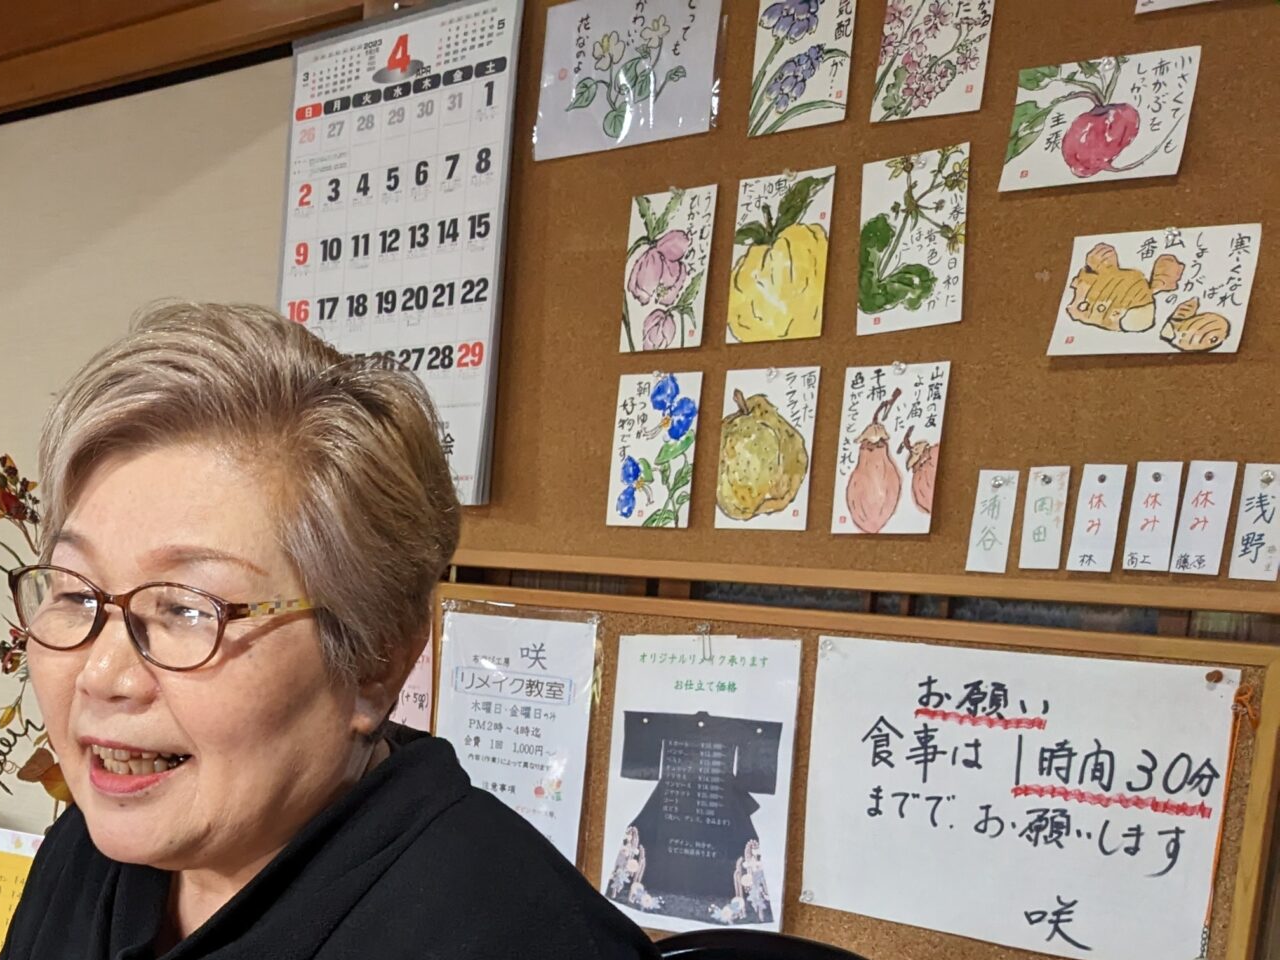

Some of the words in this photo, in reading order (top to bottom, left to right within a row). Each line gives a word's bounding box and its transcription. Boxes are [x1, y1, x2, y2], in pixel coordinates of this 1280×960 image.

[387, 34, 411, 73] 4
[305, 106, 313, 118] 日
[333, 100, 341, 111] 月
[362, 93, 371, 105] 火
[392, 86, 403, 98] 水
[422, 78, 432, 90] 木
[452, 69, 463, 82] 金
[485, 61, 497, 74] 土
[298, 126, 316, 144] 26
[327, 121, 345, 138] 27
[356, 113, 374, 132] 28
[387, 107, 406, 126] 29
[416, 99, 434, 119] 30
[447, 92, 464, 111] 31
[484, 81, 495, 107] 1
[298, 183, 312, 207] 2
[327, 178, 341, 202] 3
[356, 173, 370, 196] 4
[385, 167, 400, 191] 5
[415, 161, 429, 185] 6
[445, 154, 460, 180] 7
[475, 148, 491, 174] 8
[294, 242, 309, 266] 9
[320, 237, 342, 262] 10
[351, 233, 370, 257] 11
[379, 229, 400, 254] 12
[408, 223, 429, 249] 13
[437, 218, 459, 244] 14
[468, 213, 490, 239] 15
[287, 300, 310, 322] 16
[317, 297, 339, 320] 17
[346, 294, 368, 317] 18
[375, 290, 397, 314] 19
[401, 286, 428, 311] 20
[432, 282, 455, 308] 21
[461, 277, 489, 304] 22
[398, 348, 425, 371] 27
[427, 345, 454, 370] 28
[456, 341, 485, 368] 29
[1086, 493, 1107, 535] 休み
[1140, 492, 1162, 531] 休み
[1191, 489, 1215, 531] 休み
[1238, 492, 1276, 564] 浅野
[520, 642, 547, 670] 咲
[461, 671, 565, 700] リメイク教室
[917, 675, 1049, 720] お願い
[1024, 895, 1093, 951] 咲
